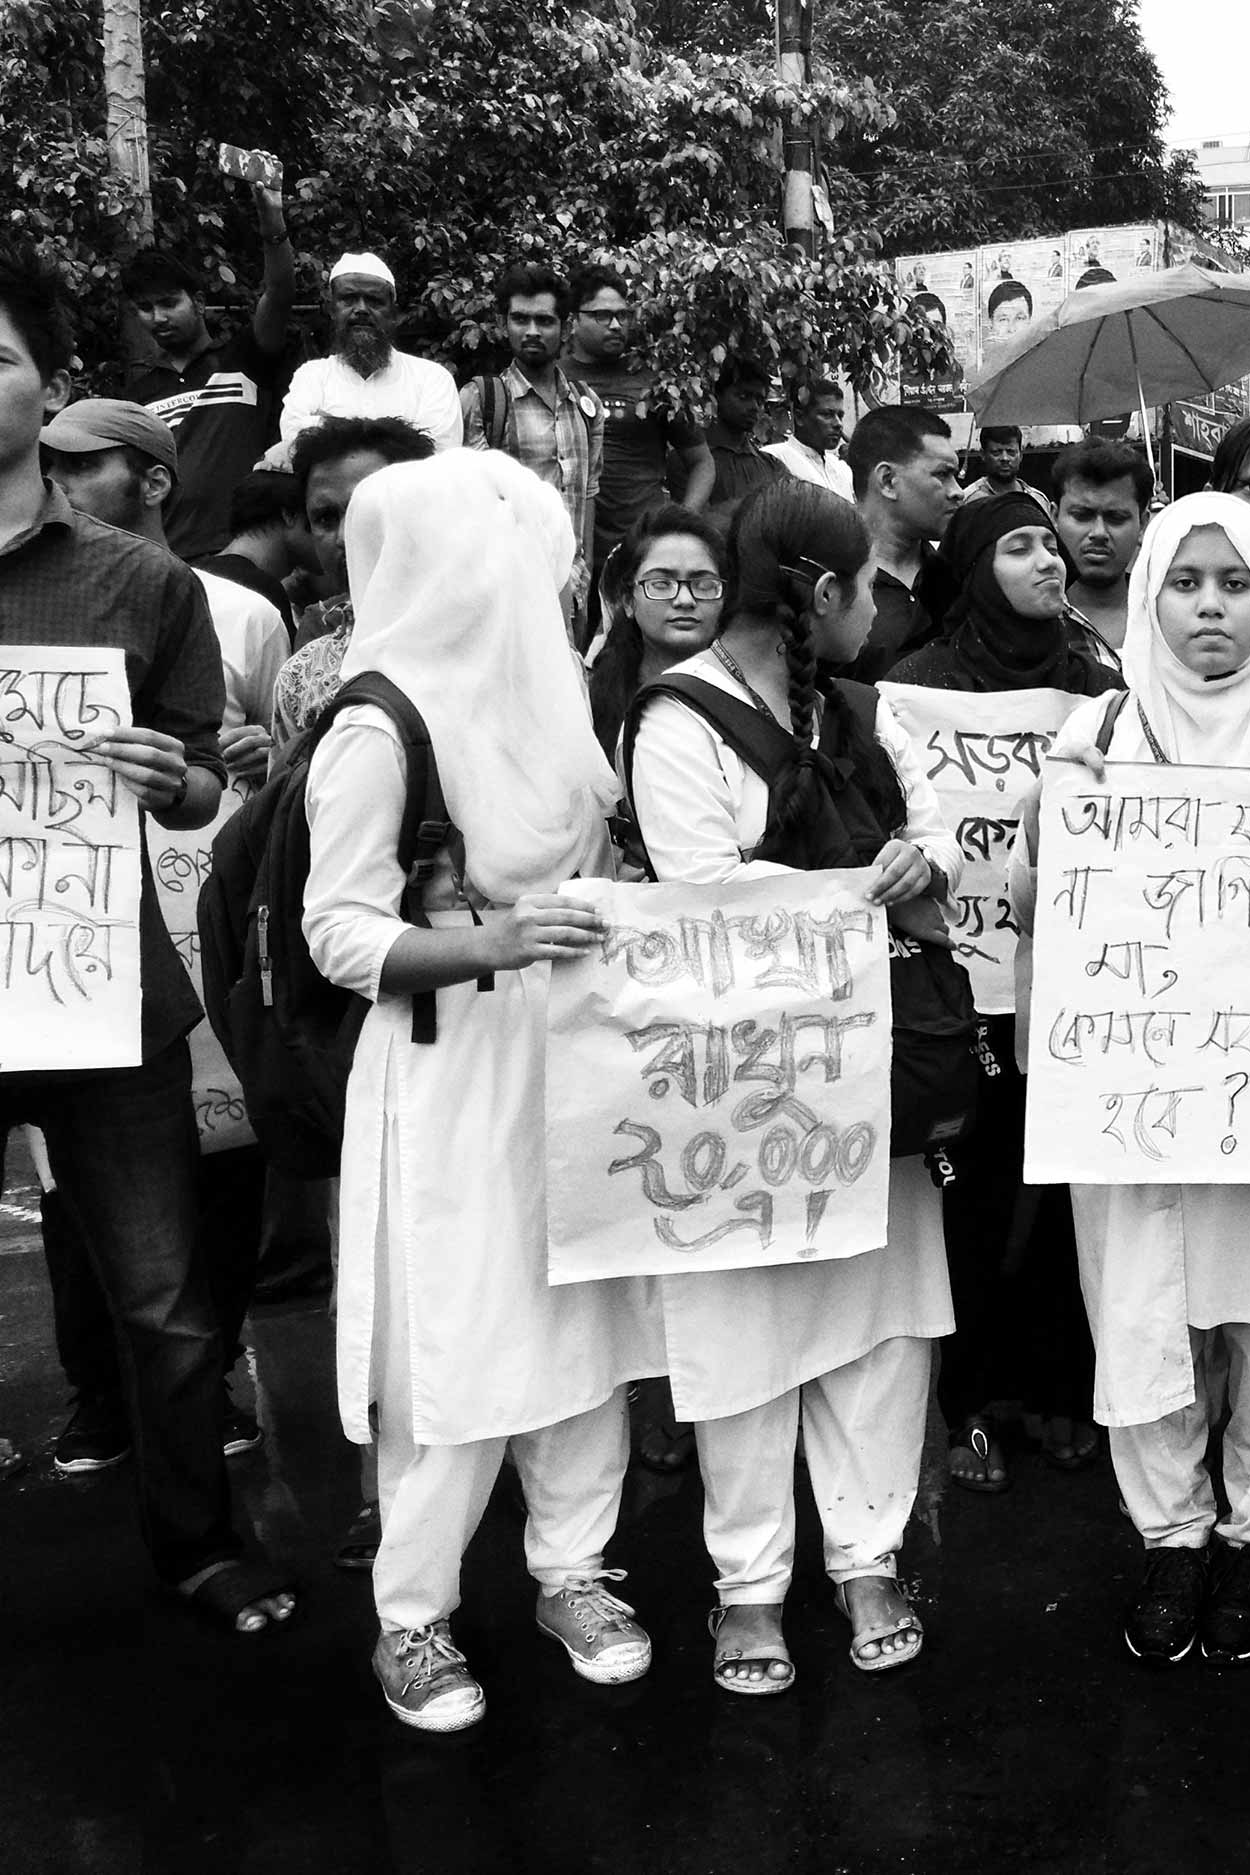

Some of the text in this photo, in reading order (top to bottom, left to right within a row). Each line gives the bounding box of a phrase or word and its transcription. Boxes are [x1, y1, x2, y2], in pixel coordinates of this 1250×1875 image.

[1062, 794, 1222, 851] আমরা
[1053, 866, 1113, 930] না
[1048, 1008, 1192, 1068] কেমনে
[624, 1010, 878, 1134] রাখুন
[608, 1118, 877, 1212] ২০,০০০
